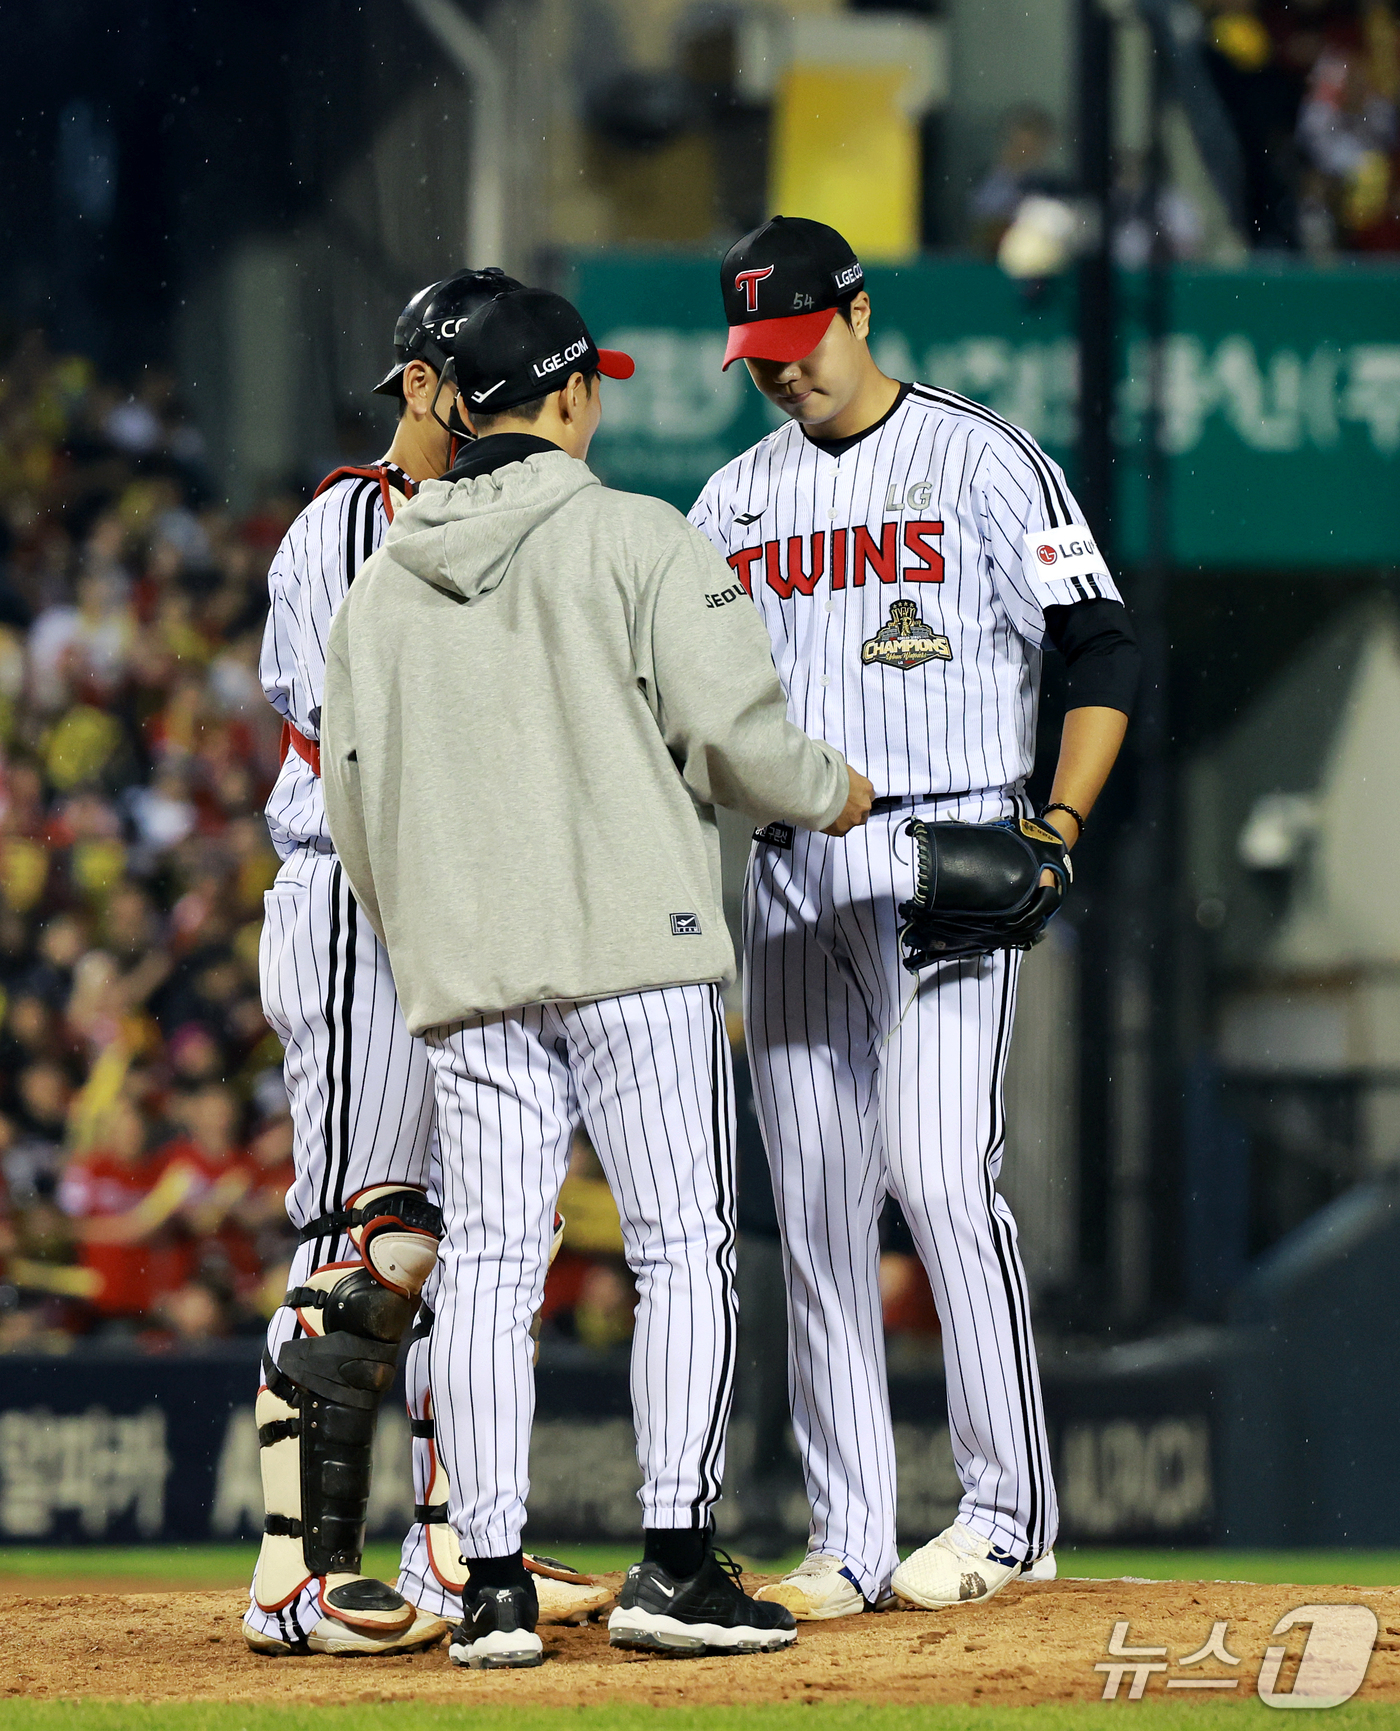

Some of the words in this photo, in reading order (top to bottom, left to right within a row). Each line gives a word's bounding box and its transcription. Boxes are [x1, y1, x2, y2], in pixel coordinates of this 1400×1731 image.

[735, 264, 775, 312] T
[793, 292, 815, 310] 54
[532, 337, 589, 378] LGE.COM
[886, 481, 933, 511] LG
[726, 520, 945, 601] TWINS
[1059, 541, 1083, 558] LG
[865, 638, 948, 660] CHAMPIONS
